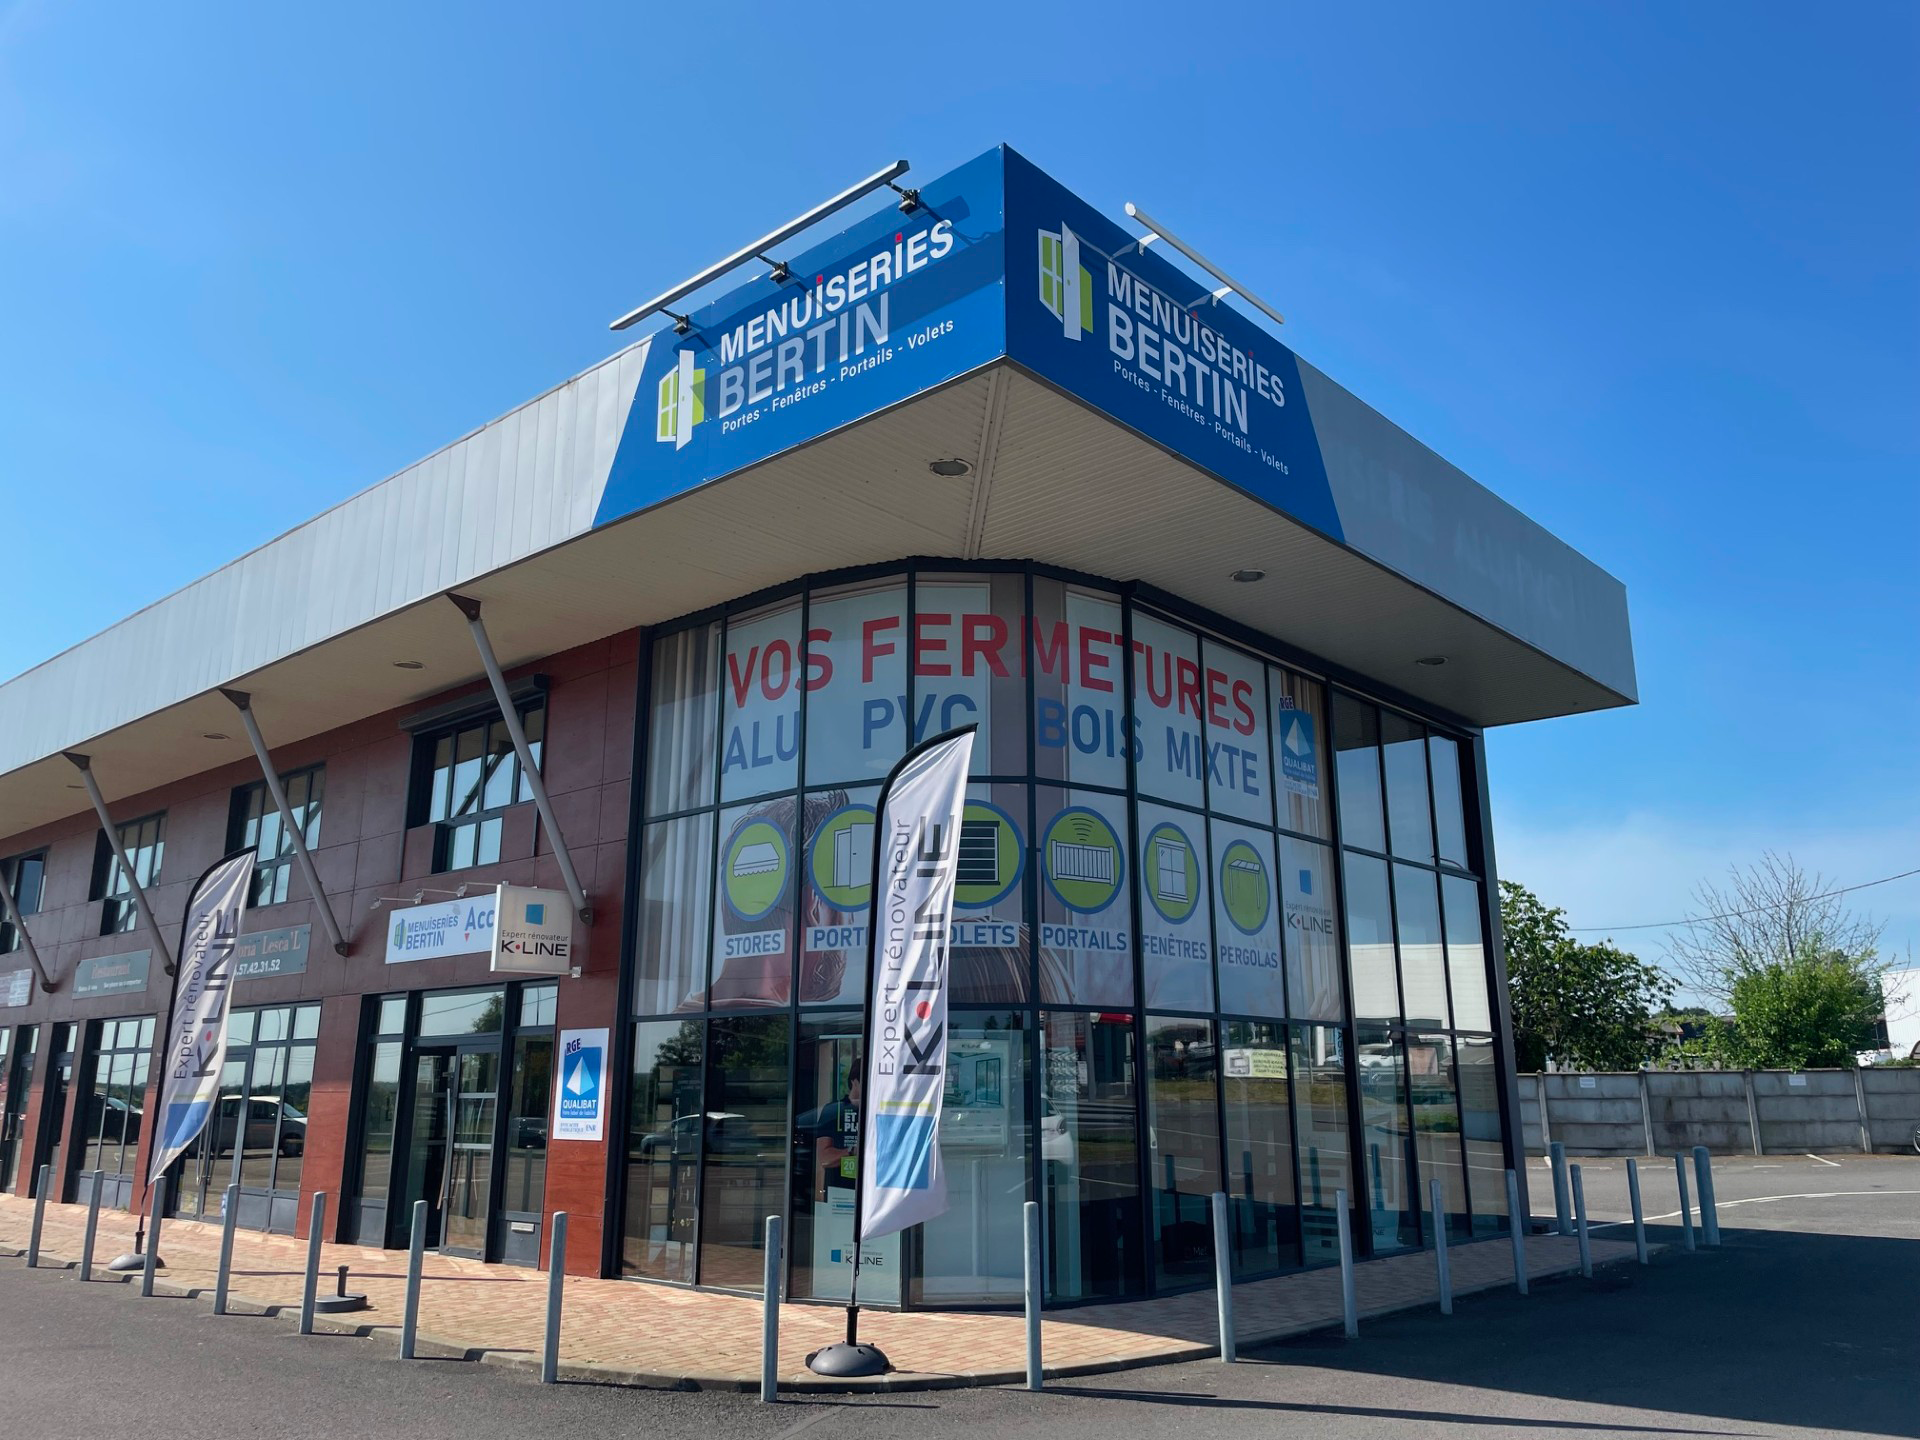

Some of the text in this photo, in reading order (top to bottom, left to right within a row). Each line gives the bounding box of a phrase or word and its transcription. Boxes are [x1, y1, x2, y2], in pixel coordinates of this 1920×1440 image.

[719, 292, 889, 418] BERTIN
[1108, 302, 1248, 435] BERTIN
[722, 407, 760, 434] Portes
[772, 378, 826, 412] Fenêtres
[840, 348, 893, 383] Portails
[908, 319, 954, 350] Volets
[1114, 360, 1150, 393] Portes
[1161, 388, 1205, 426] Fenêtres
[1215, 421, 1252, 455] Portails
[1261, 448, 1289, 476] Volets
[727, 613, 1256, 736] VOS FERMETURES
[722, 693, 1260, 796] ALU PVC BOIS MIXTE
[406, 930, 446, 950] BERTIN
[502, 930, 569, 942] Expert rénovateur
[726, 933, 782, 956] STORES
[813, 926, 868, 949] PORT
[878, 818, 911, 1076] Expert rénovateur
[1042, 927, 1127, 950] PORTAILS
[1143, 933, 1207, 960] FENÊTRES
[1220, 945, 1278, 969] PERGOLAS
[173, 913, 210, 1080] Expert rénovateur
[566, 1038, 581, 1055] RGE
[563, 1099, 597, 1109] QUALIBAT
